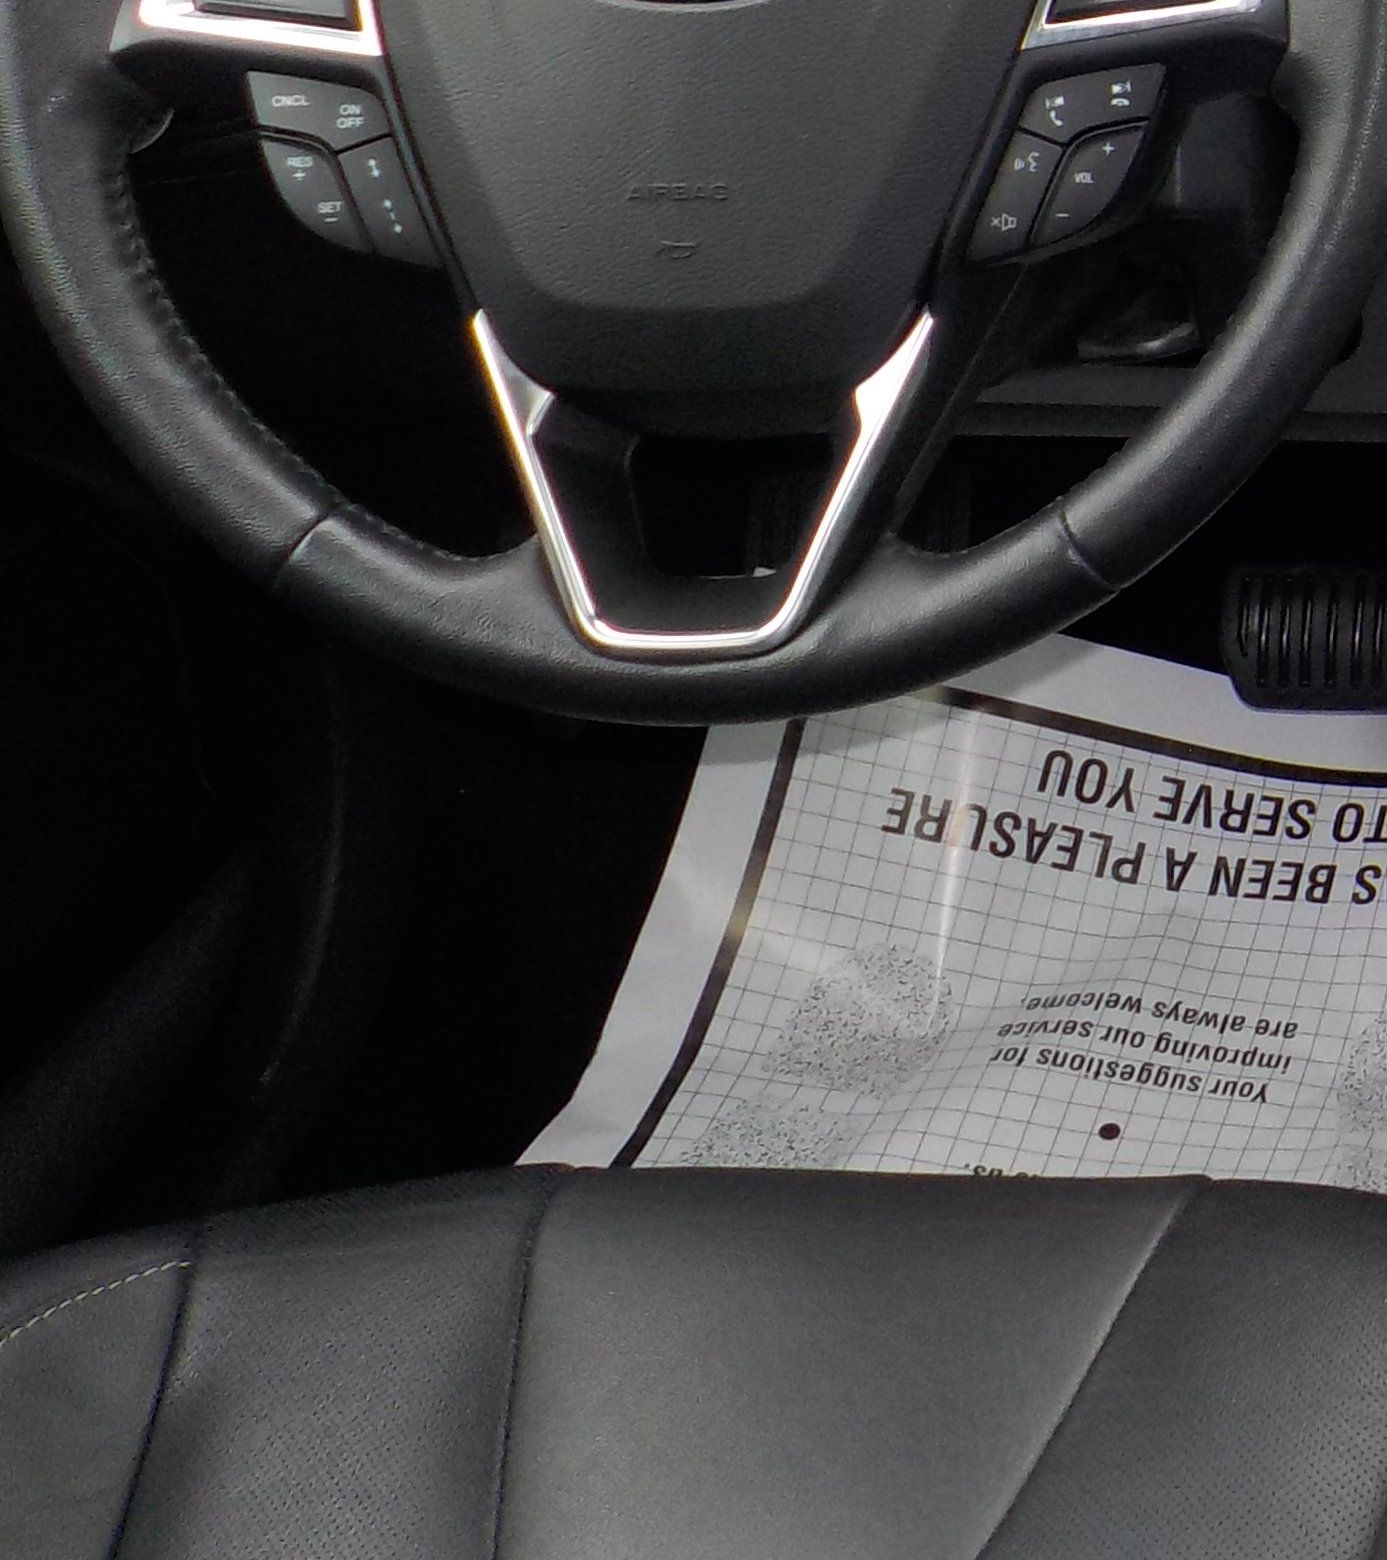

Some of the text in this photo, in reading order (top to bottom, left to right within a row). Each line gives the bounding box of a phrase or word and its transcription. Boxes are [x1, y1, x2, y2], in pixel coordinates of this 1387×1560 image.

[271, 94, 310, 107] CNCL
[336, 117, 365, 129] OFF
[340, 104, 361, 117] ON
[287, 156, 313, 168] RES
[1074, 171, 1095, 184] VOL
[318, 202, 343, 213] SET
[1037, 749, 1136, 814] YOU
[1153, 775, 1317, 838] SERVE
[881, 787, 1147, 885] PLEASURE
[1165, 846, 1198, 892] A
[1207, 855, 1338, 904] BEEN
[1020, 992, 1298, 1040] are always welcome.
[998, 1019, 1292, 1075] improving our service
[989, 1046, 1269, 1103] Your suggestions for
